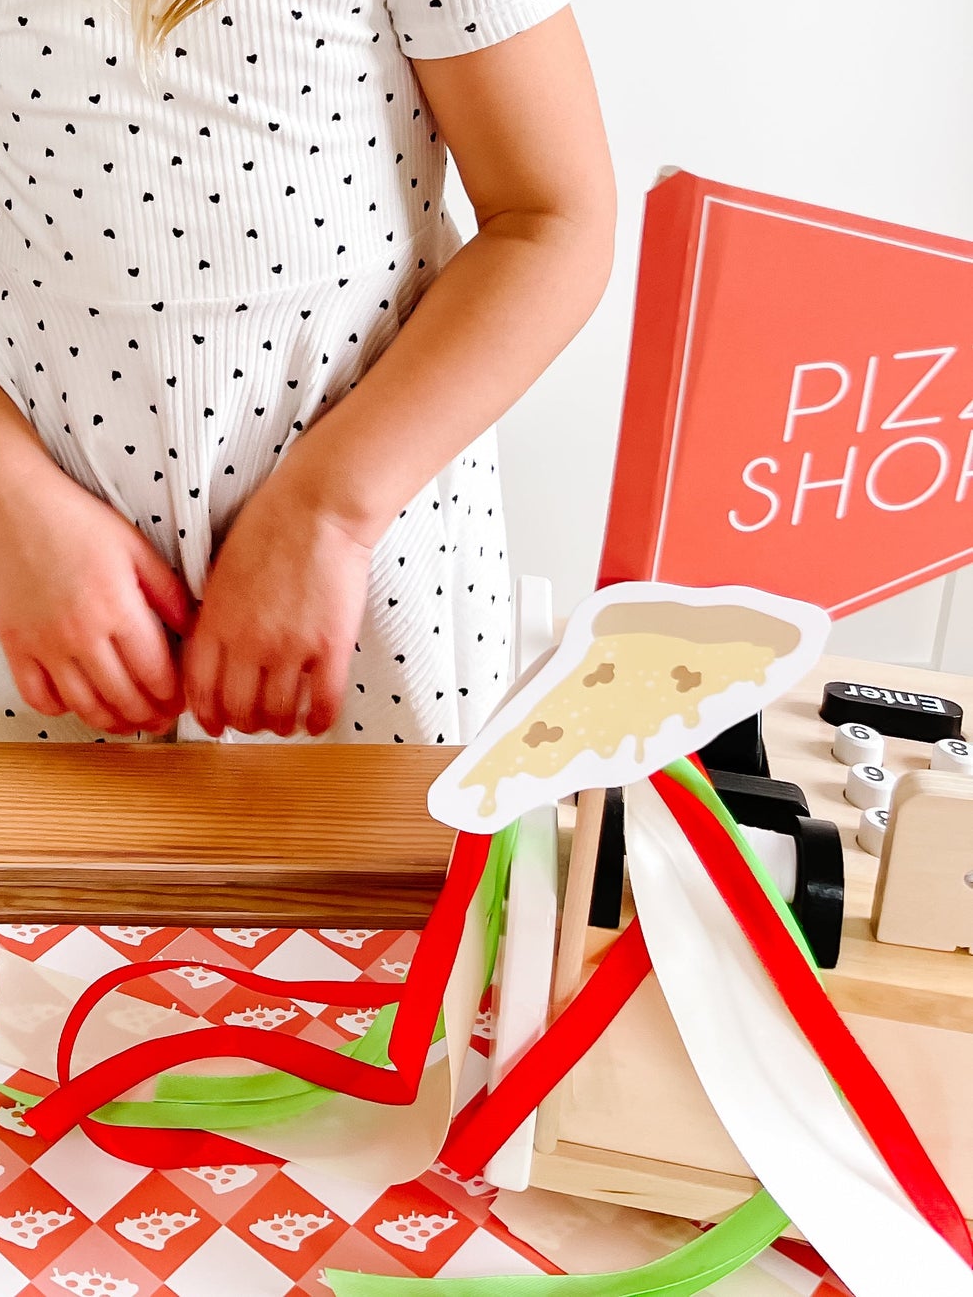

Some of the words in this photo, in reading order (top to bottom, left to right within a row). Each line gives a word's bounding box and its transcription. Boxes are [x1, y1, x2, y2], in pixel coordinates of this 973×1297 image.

[782, 346, 973, 443] PIZ
[844, 685, 946, 714] Enter
[947, 741, 969, 756] 8
